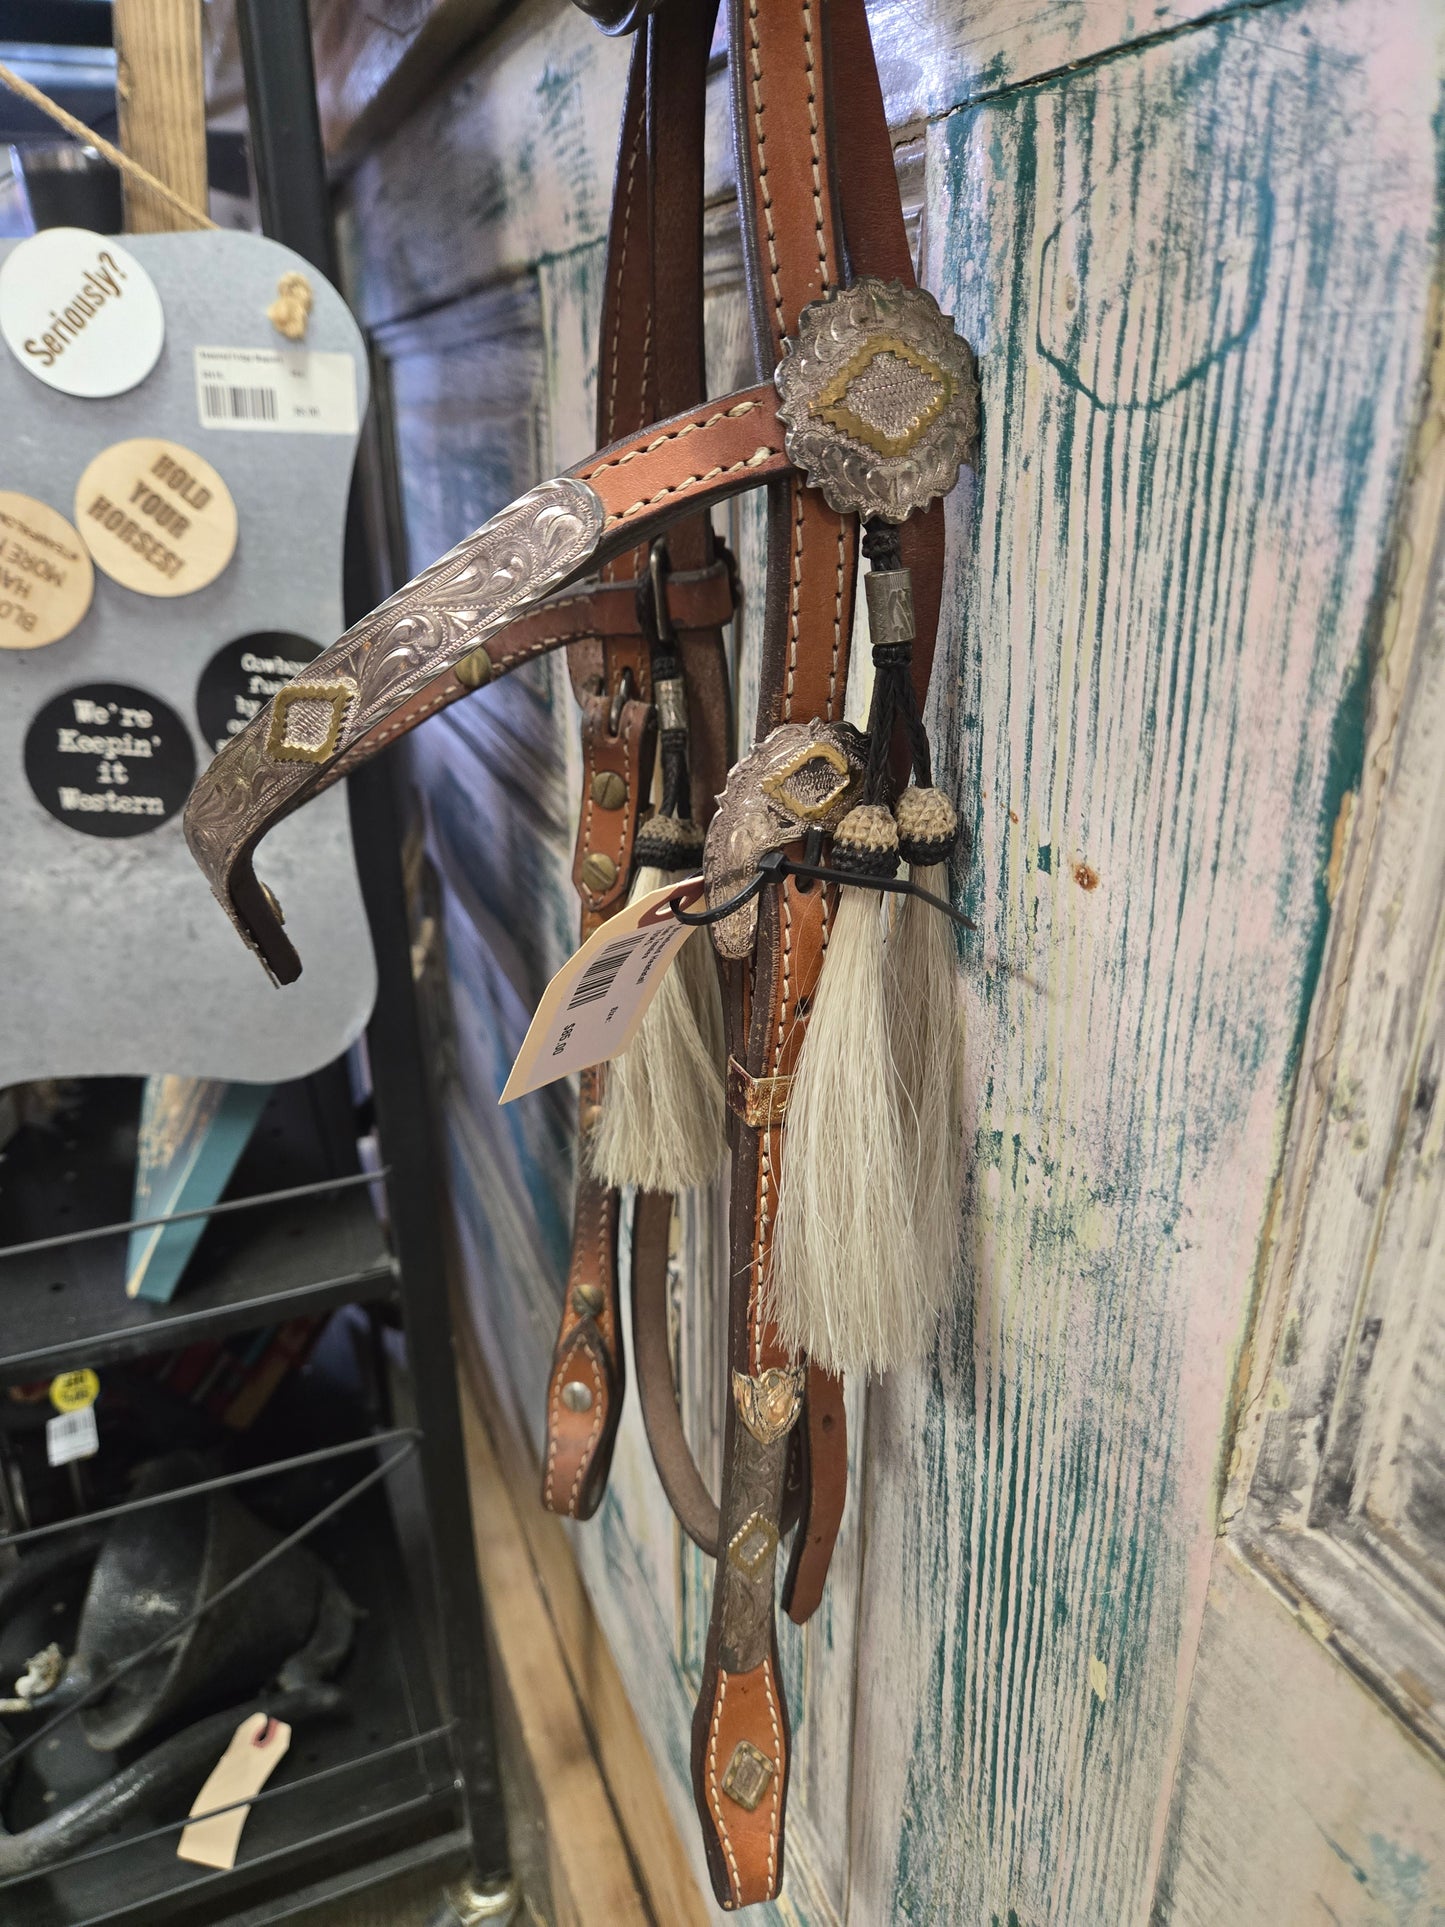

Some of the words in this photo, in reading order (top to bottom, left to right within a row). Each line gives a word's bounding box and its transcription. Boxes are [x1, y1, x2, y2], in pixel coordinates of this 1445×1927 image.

[24, 251, 128, 367] Seriously?
[151, 454, 213, 511] HOLD
[129, 480, 191, 540] YOUR
[86, 495, 186, 580] HORSES!
[73, 699, 153, 729] We're
[57, 728, 162, 759] Keepin'
[96, 761, 129, 785] it
[58, 786, 165, 816] Western
[552, 1022, 576, 1056] $85.00
